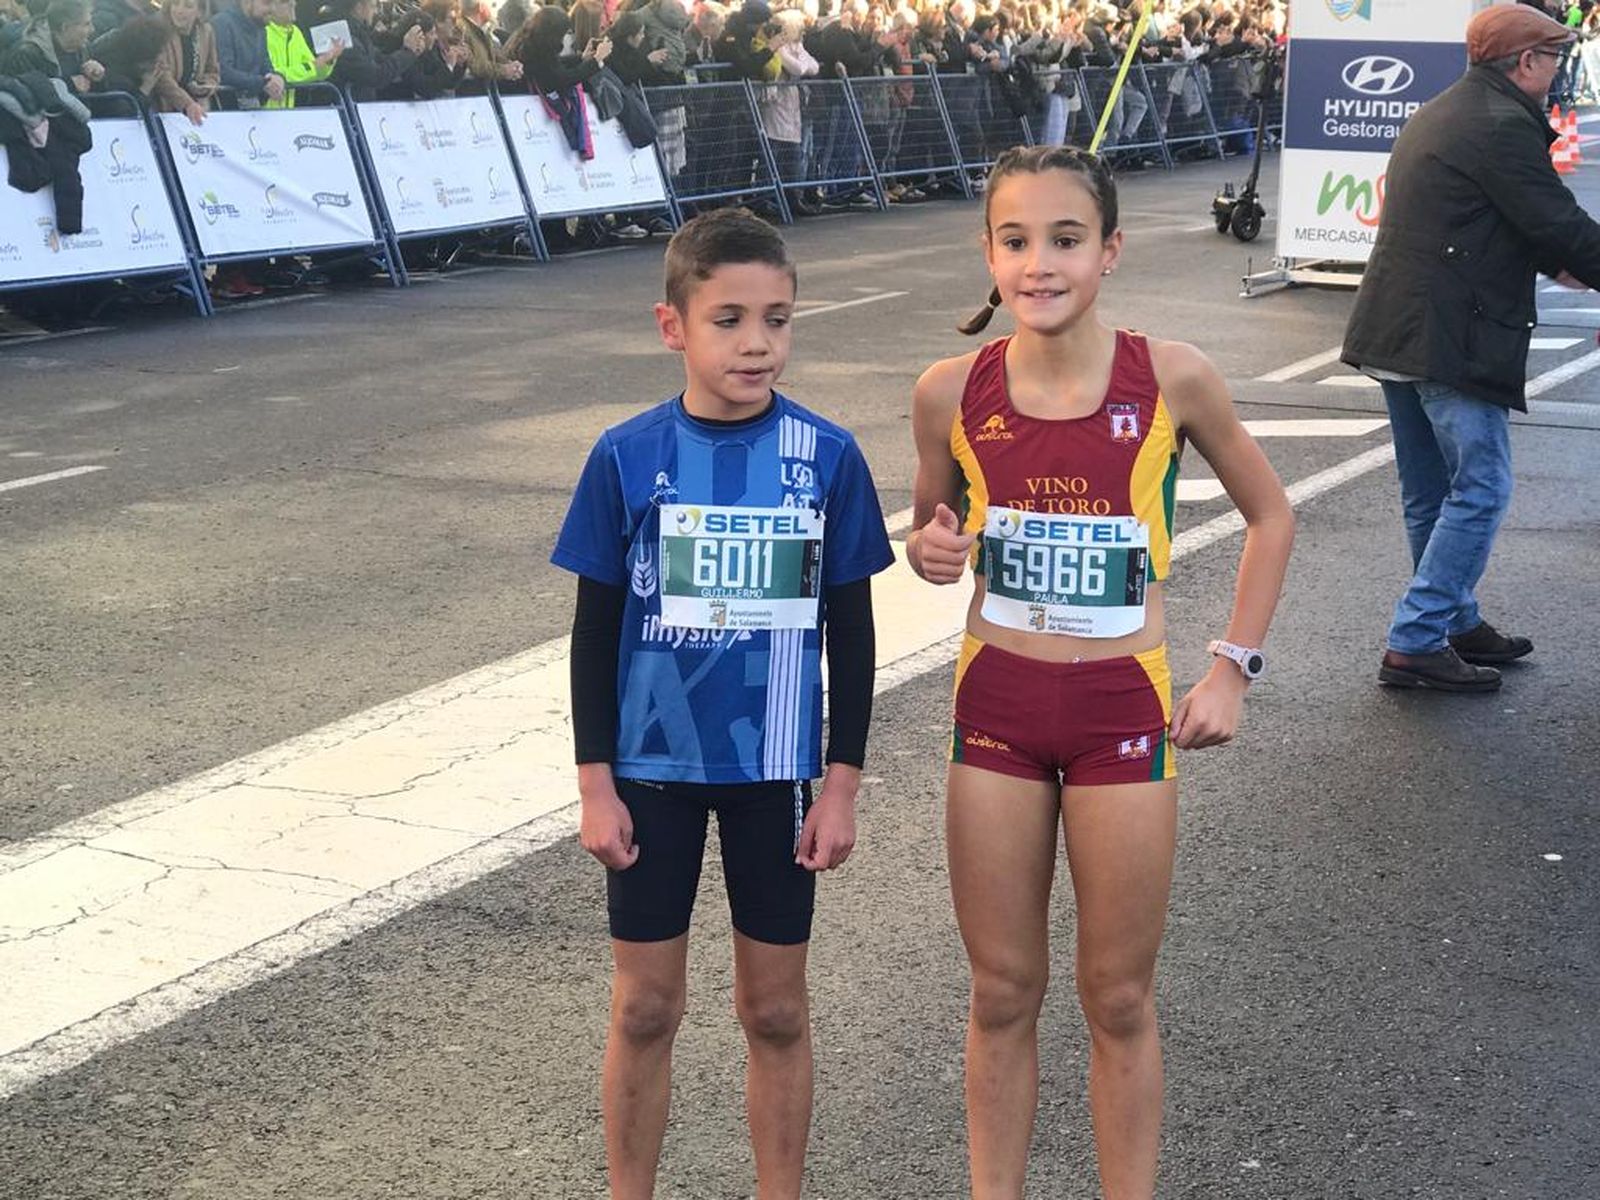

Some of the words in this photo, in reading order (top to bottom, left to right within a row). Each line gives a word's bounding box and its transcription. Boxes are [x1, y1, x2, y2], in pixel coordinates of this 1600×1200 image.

[1324, 99, 1425, 119] HYUNDA
[1026, 476, 1089, 496] VINO
[1008, 499, 1036, 513] DE
[1042, 498, 1111, 515] TORO
[704, 513, 809, 534] SETEL
[1023, 519, 1132, 543] SETEL
[692, 538, 774, 589] 6011
[1002, 542, 1107, 596] 5966
[701, 587, 764, 599] GUILLERMO
[1033, 592, 1069, 604] PAULA
